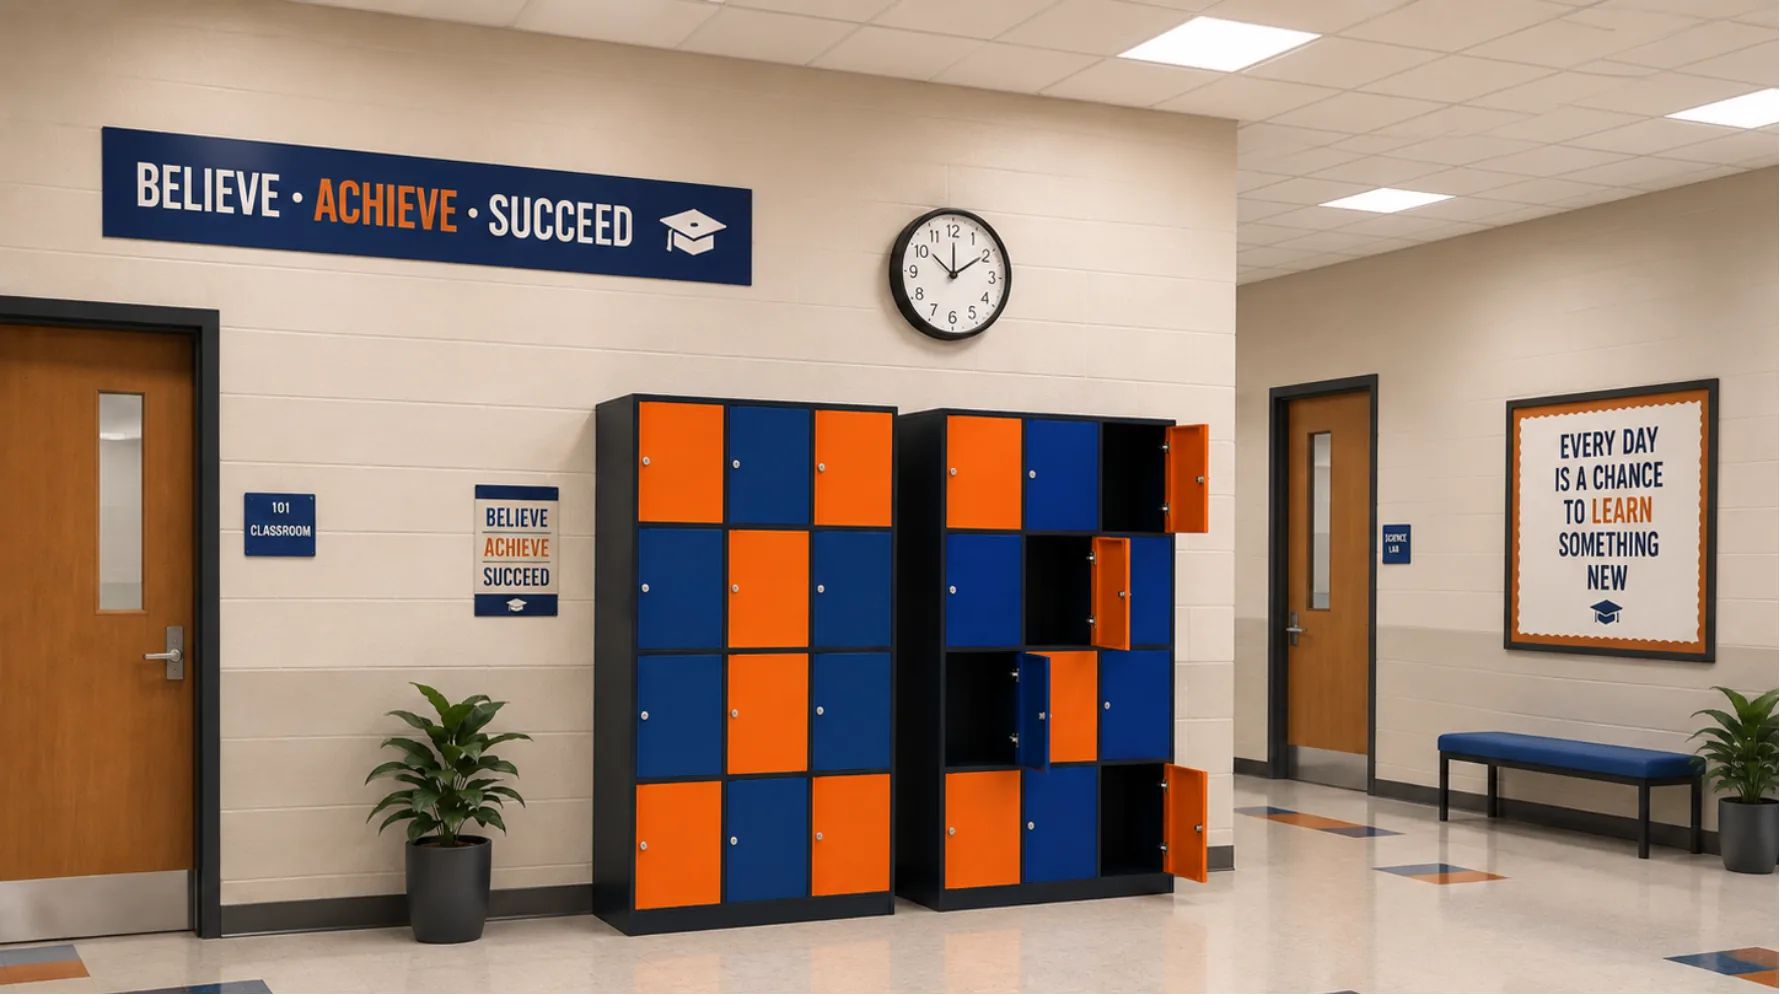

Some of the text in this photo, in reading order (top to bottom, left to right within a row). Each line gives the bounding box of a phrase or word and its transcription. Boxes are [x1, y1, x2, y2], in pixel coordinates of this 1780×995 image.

[137, 161, 633, 247] BELIEVE ACHIEVE SUCCEED
[930, 229, 940, 243] 11
[946, 224, 960, 239] 12
[971, 232, 975, 246] 1
[914, 244, 929, 258] 10
[981, 249, 990, 263] 2
[909, 264, 918, 279] 9
[988, 271, 996, 285] 3
[915, 287, 924, 301] 8
[980, 291, 990, 305] 4
[930, 303, 938, 316] 7
[948, 310, 957, 324] 6
[968, 305, 977, 320] 5
[1560, 425, 1659, 459] EVERY DAY
[1555, 461, 1664, 492] IS A CHANCE
[272, 501, 290, 514] 101
[1564, 496, 1653, 524] TO LEARN
[486, 507, 549, 528] BELIEVE
[250, 524, 312, 537] CLASSROOM
[483, 537, 550, 557] ACHIEVE
[1558, 530, 1660, 558] SOMETHING
[483, 566, 550, 587] SUCCEED
[1587, 564, 1628, 591] NEW
